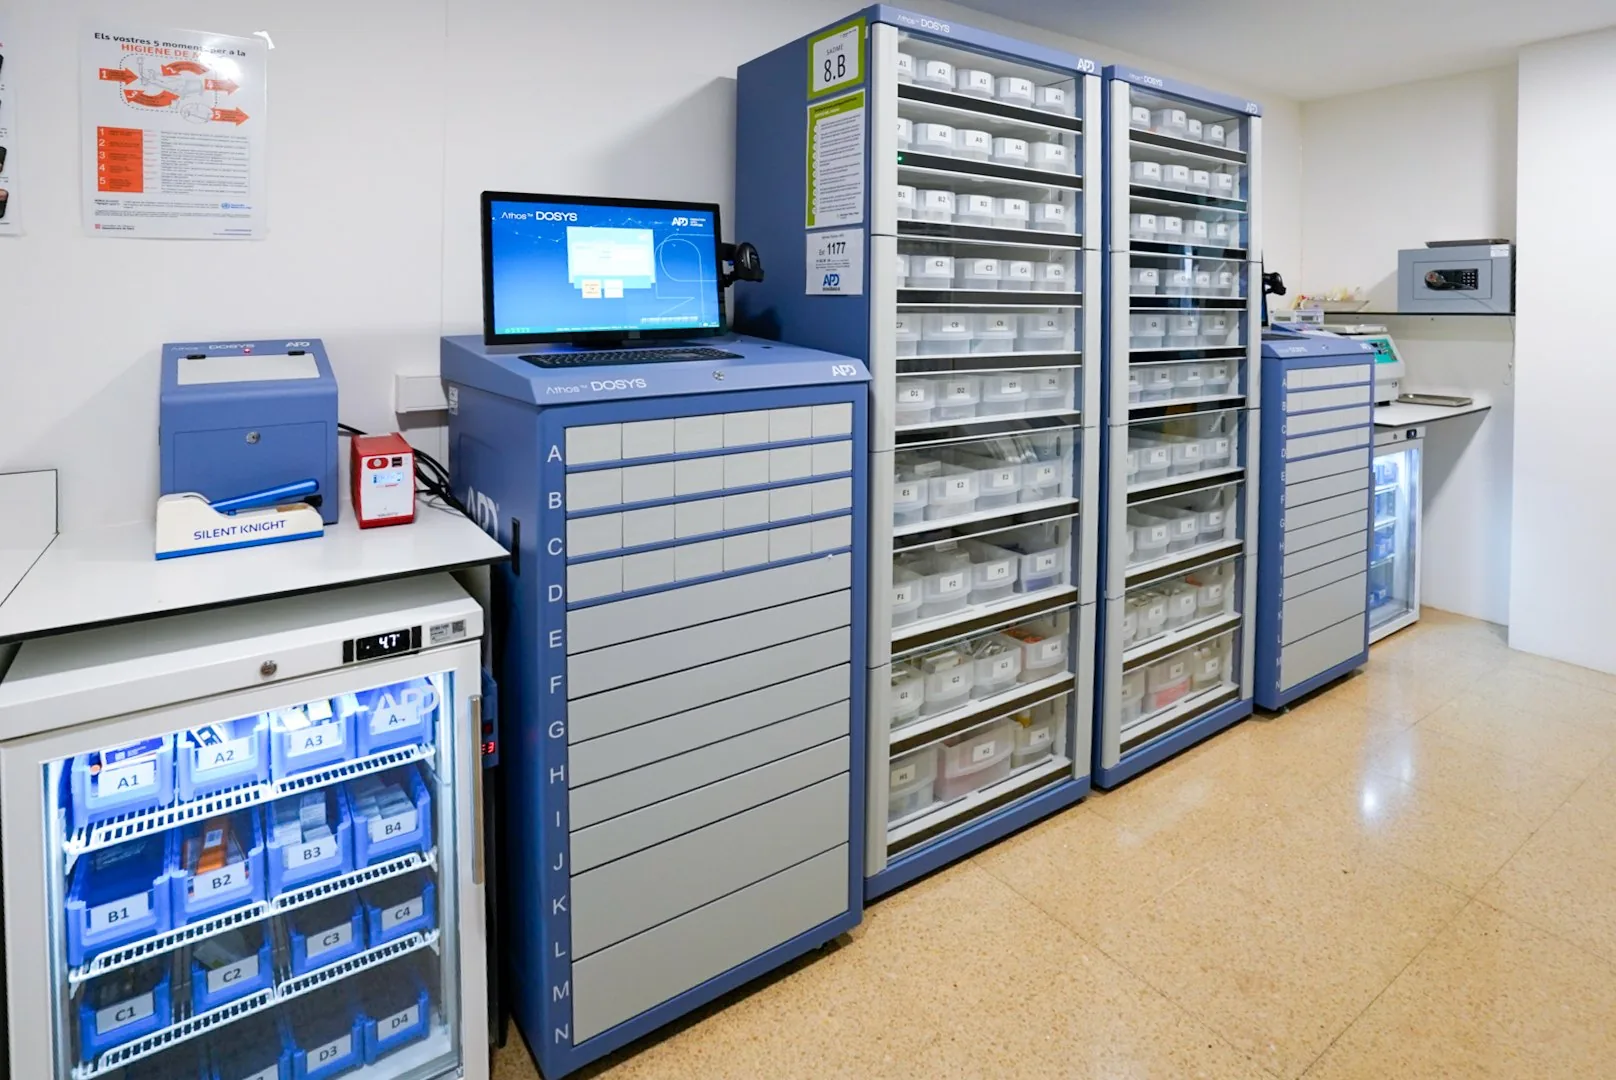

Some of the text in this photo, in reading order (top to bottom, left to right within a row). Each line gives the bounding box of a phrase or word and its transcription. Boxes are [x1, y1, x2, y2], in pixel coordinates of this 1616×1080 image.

[921, 18, 950, 32] DOSYS
[94, 32, 110, 40] Els
[113, 36, 151, 46] vostres
[121, 43, 170, 56] HIGIENE
[174, 49, 188, 58] DE
[824, 54, 846, 82] 8.B
[1077, 58, 1095, 72] APD
[536, 211, 578, 222] DOSYS
[672, 217, 688, 226] APD
[827, 241, 846, 255] 1177
[823, 274, 840, 286] APD
[832, 365, 856, 376] APD
[590, 379, 646, 392] DOSYS
[1282, 378, 1286, 387] A
[1282, 426, 1286, 435] C
[547, 444, 562, 462] A
[1281, 472, 1285, 481] E
[549, 492, 562, 509] B
[1280, 495, 1285, 504] F
[193, 520, 286, 540] SILENT KNIGHT
[1280, 519, 1285, 527] G
[547, 538, 562, 555] C
[549, 584, 562, 602] D
[1279, 588, 1282, 597] J
[1278, 612, 1283, 620] K
[549, 630, 562, 648] E
[1277, 635, 1281, 643] L
[550, 676, 562, 694] F
[1276, 681, 1281, 689] N
[548, 721, 564, 738] G
[304, 734, 323, 748] A3
[214, 750, 234, 764] A2
[550, 764, 564, 784] H
[118, 774, 139, 790] A1
[556, 811, 560, 827] I
[385, 821, 402, 836] B4
[303, 846, 322, 860] B3
[553, 853, 563, 871] J
[212, 874, 232, 889] B2
[394, 906, 411, 919] C4
[553, 895, 566, 915] K
[108, 907, 129, 923] B1
[322, 931, 341, 946] C3
[555, 942, 566, 958] L
[223, 967, 242, 982] C2
[553, 981, 569, 1003] M
[115, 1006, 136, 1022] C1
[391, 1014, 408, 1028] D4
[555, 1024, 568, 1044] N
[319, 1046, 337, 1062] D3
